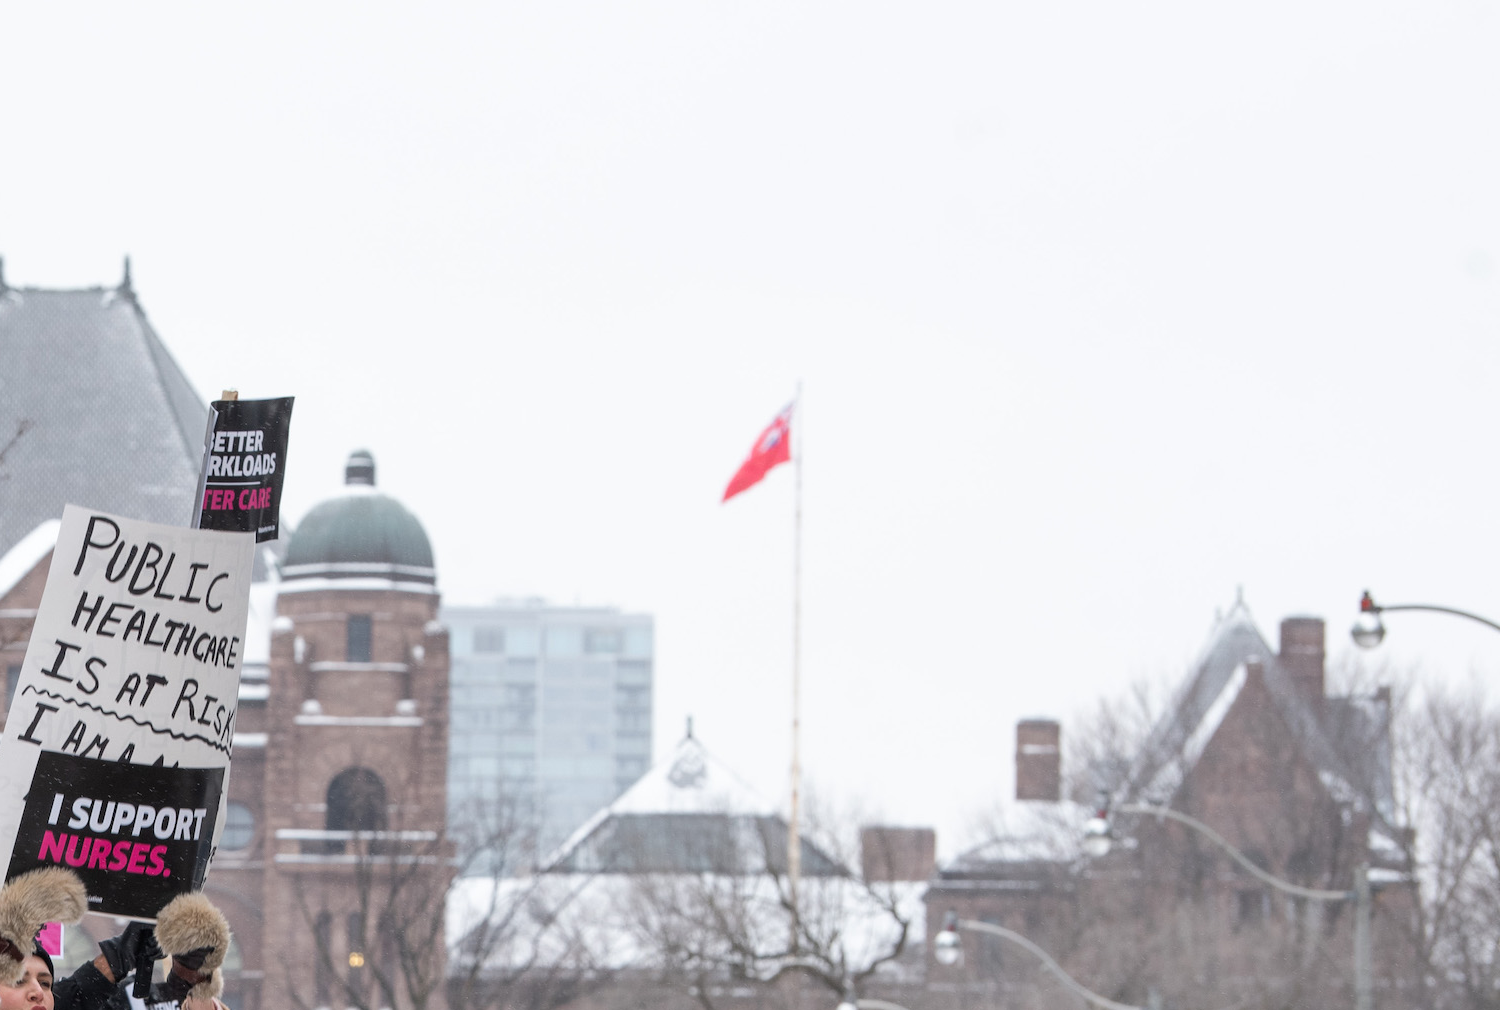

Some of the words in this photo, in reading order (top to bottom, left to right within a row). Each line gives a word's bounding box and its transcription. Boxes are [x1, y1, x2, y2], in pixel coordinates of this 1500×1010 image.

[208, 453, 276, 477] RKLOADS
[202, 489, 235, 510] TER
[238, 487, 272, 511] CARE
[73, 516, 229, 613] PUBLIC
[71, 591, 239, 669] HEALTHCARE
[41, 639, 107, 695] IS
[115, 673, 168, 707] AT
[17, 702, 60, 746] I
[47, 793, 65, 826] I
[68, 797, 207, 841] SUPPORT
[37, 830, 173, 877] NURSES.
